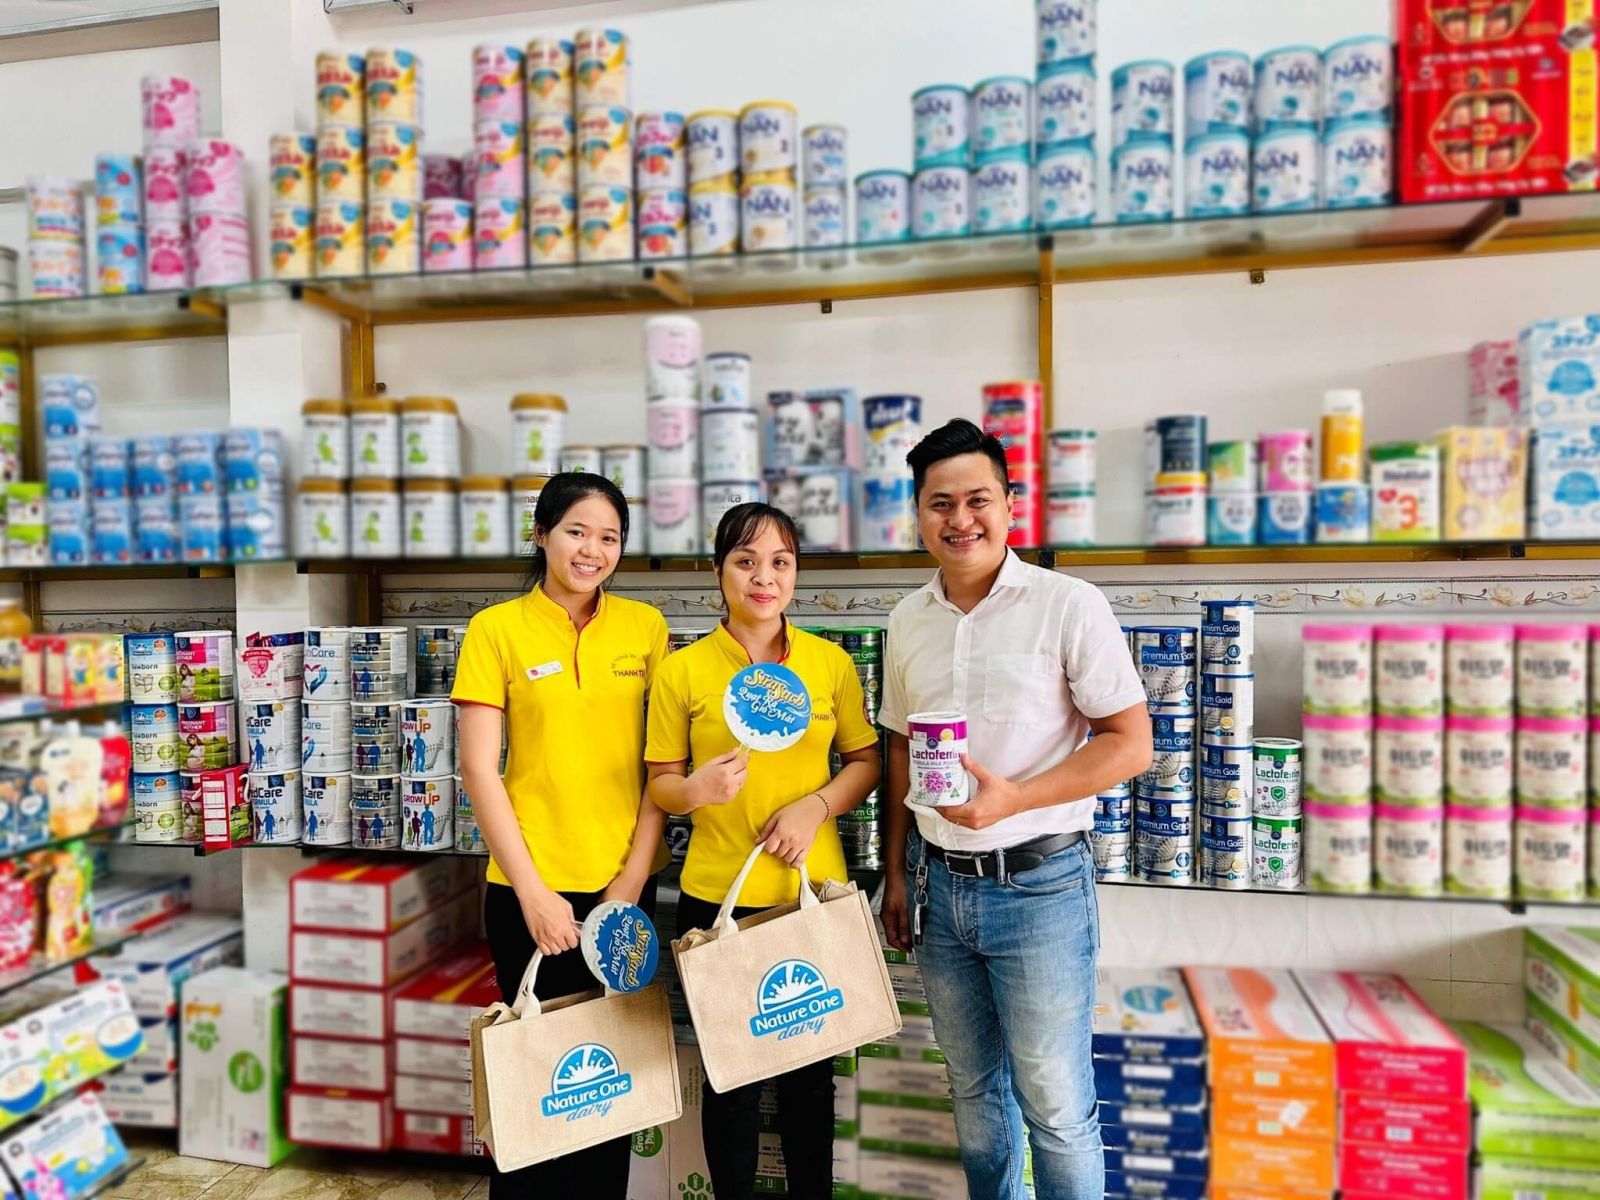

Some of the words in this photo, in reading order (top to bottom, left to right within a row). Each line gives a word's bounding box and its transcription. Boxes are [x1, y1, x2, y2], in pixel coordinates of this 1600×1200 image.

[1398, 494, 1419, 529] 3
[1142, 651, 1180, 661] Premium
[754, 1006, 808, 1032] Nature
[808, 995, 840, 1014] One
[777, 1016, 825, 1041] dairy
[546, 1089, 598, 1113] Nature
[599, 1079, 629, 1097] One
[566, 1099, 614, 1122] dairy
